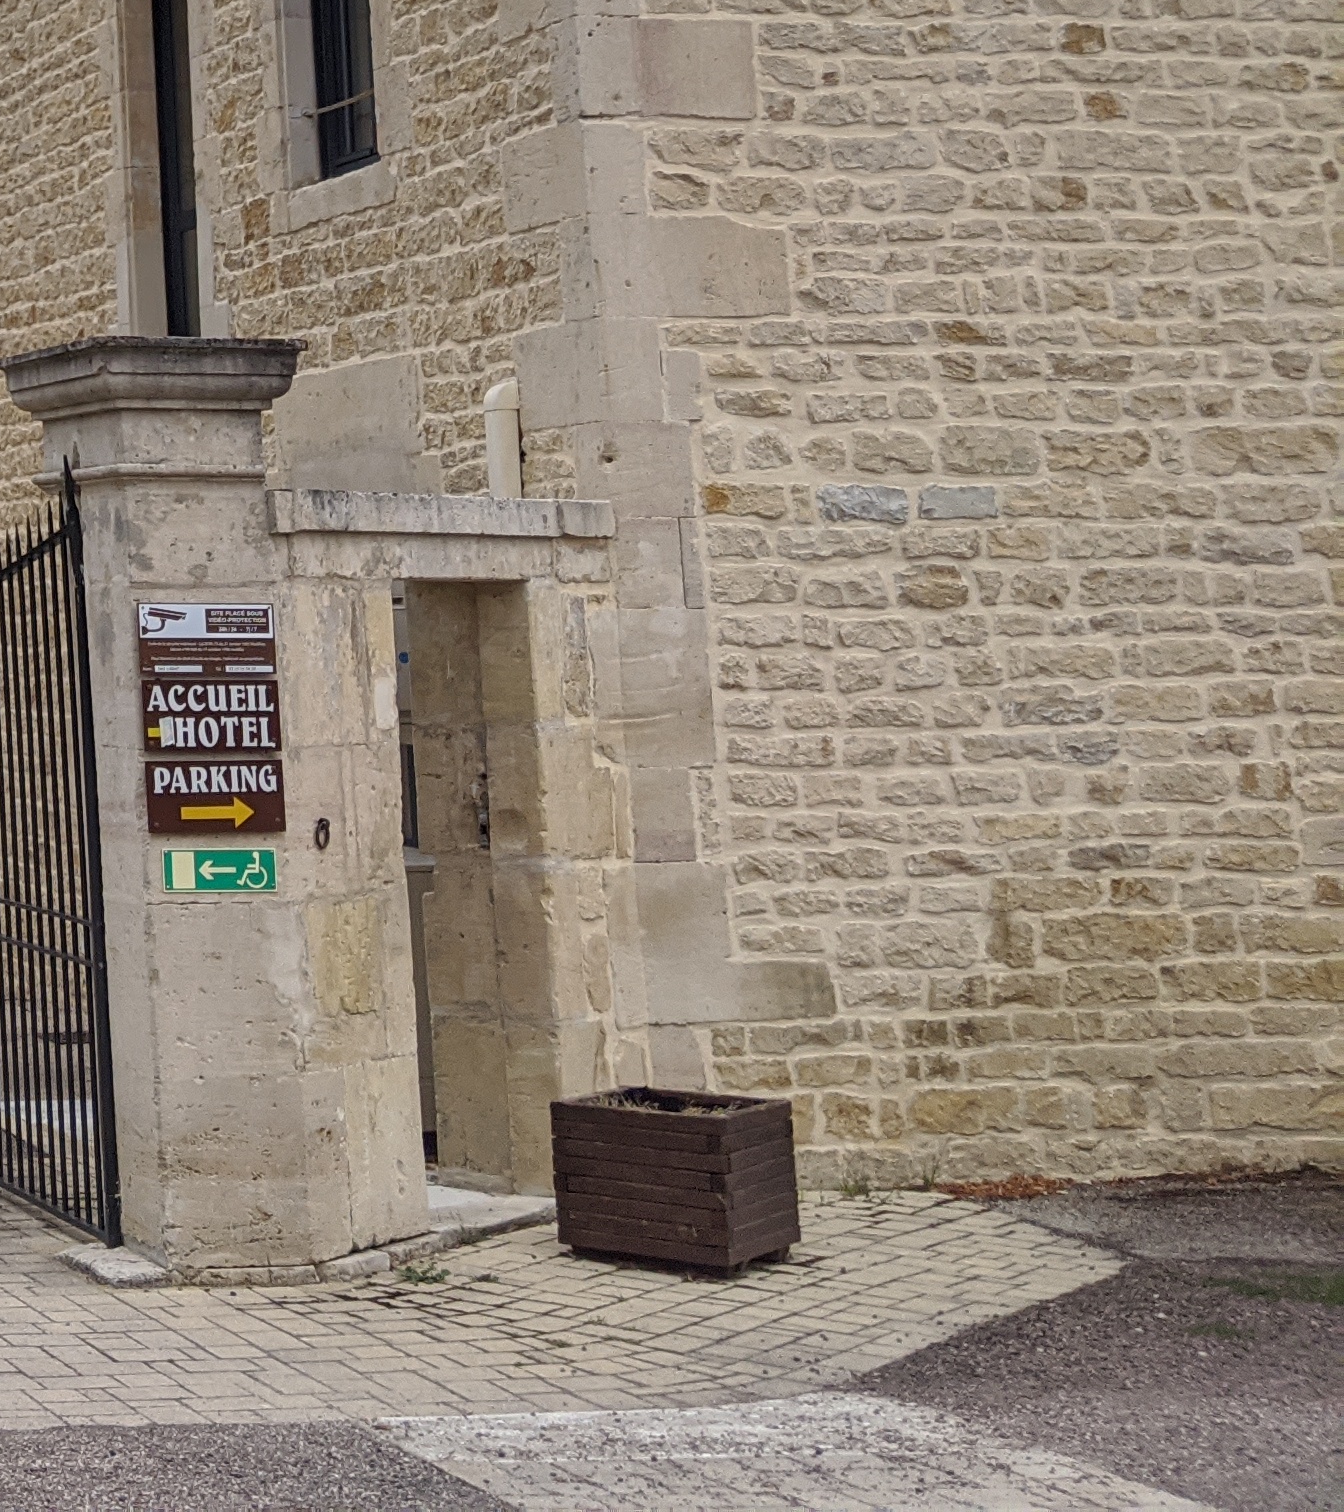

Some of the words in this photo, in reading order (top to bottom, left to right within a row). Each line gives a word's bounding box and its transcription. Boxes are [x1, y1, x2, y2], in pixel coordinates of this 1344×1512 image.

[147, 684, 274, 712] ACCUEIL
[175, 716, 276, 748] HOTEL
[153, 764, 277, 794] PARKING
